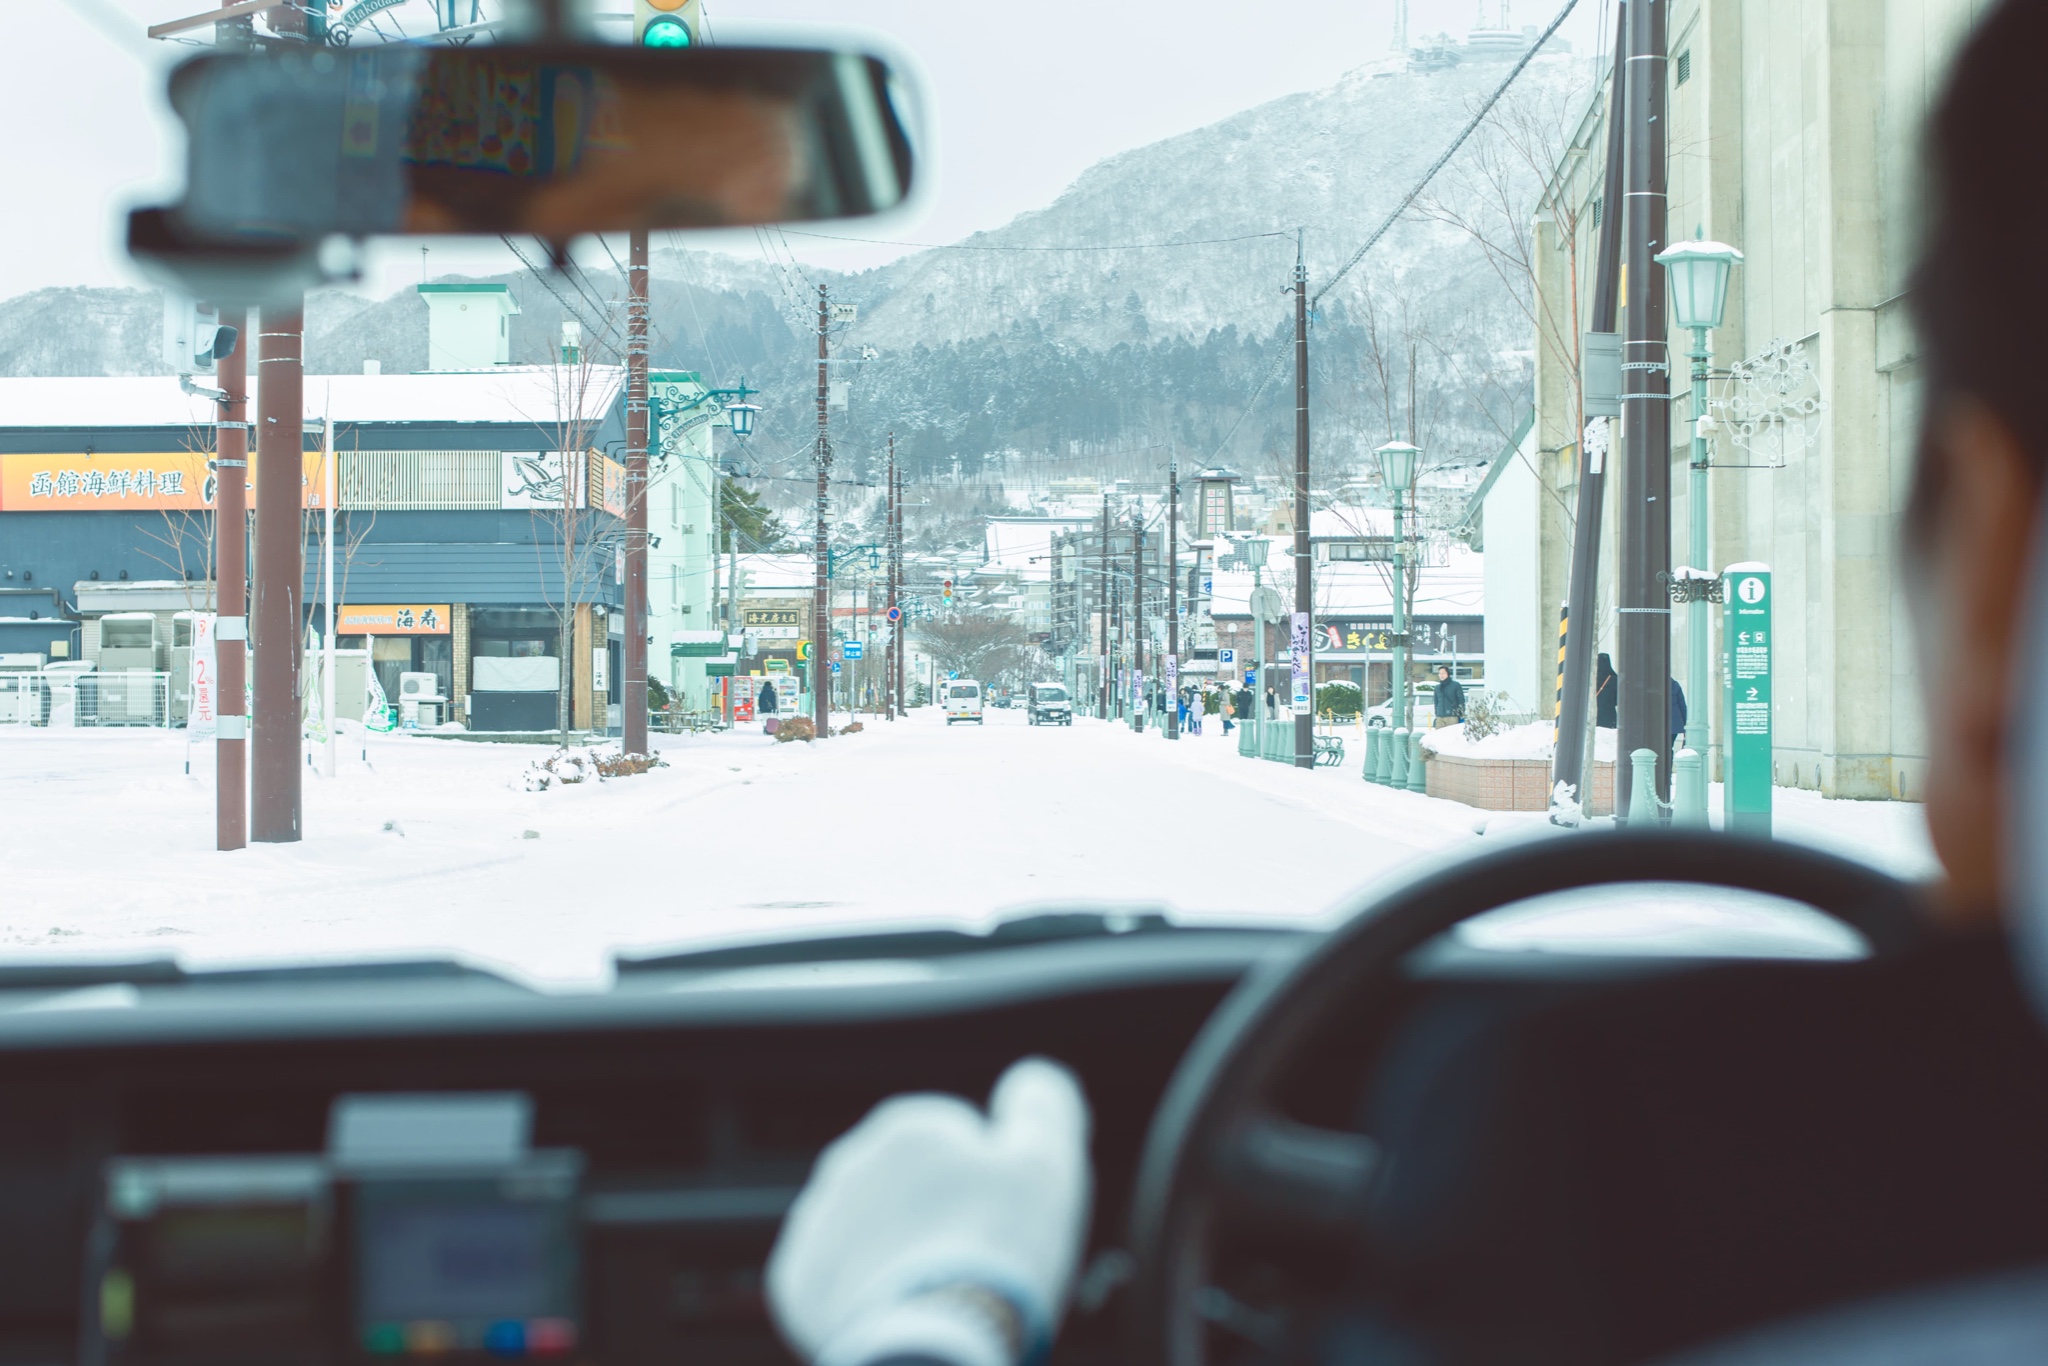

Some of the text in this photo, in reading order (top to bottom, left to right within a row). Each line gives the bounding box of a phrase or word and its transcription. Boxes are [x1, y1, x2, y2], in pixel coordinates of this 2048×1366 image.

[347, 0, 402, 25] Hakoda
[31, 470, 185, 499] 函館海鮮料理
[397, 608, 438, 630] 海寿
[1222, 651, 1231, 662] P
